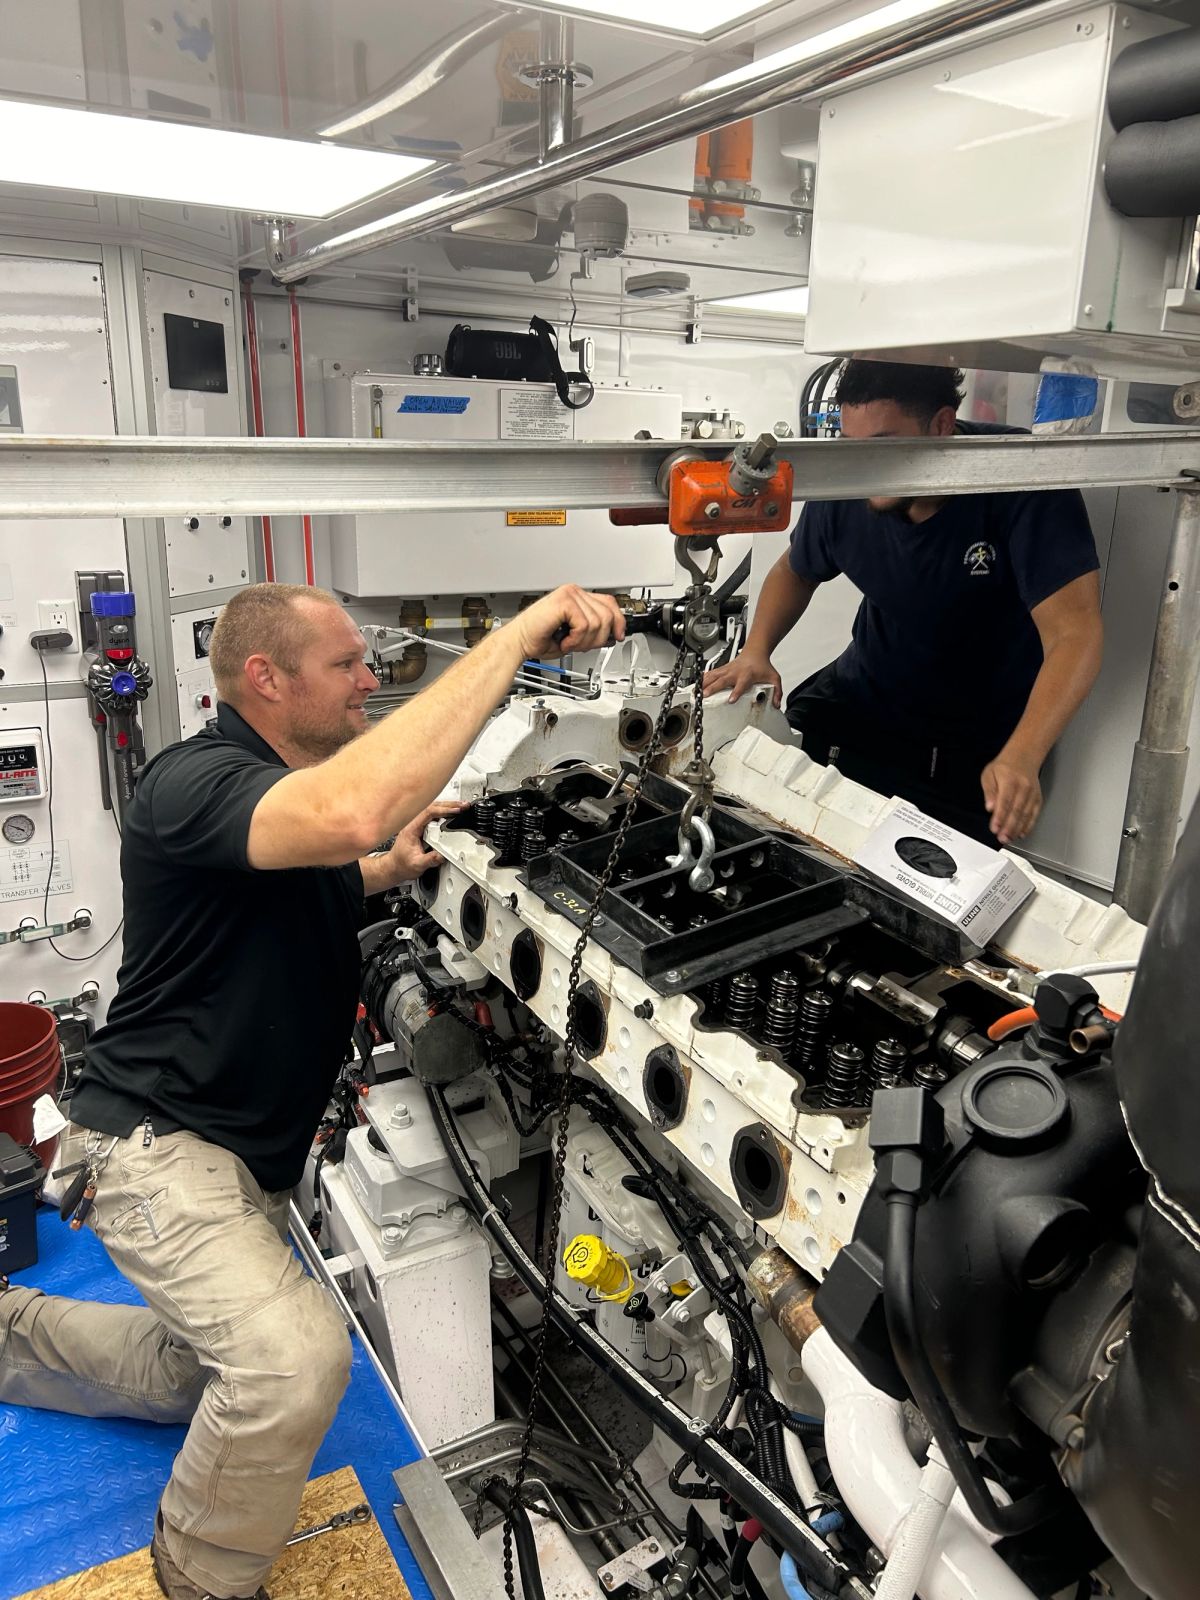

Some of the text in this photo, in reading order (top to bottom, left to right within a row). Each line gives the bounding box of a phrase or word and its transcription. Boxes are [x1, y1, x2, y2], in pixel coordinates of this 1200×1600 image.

[495, 341, 521, 359] JBL
[896, 873, 917, 889] GLOVES
[1, 888, 39, 899] TRANSFER
[961, 905, 981, 927] ULINE
